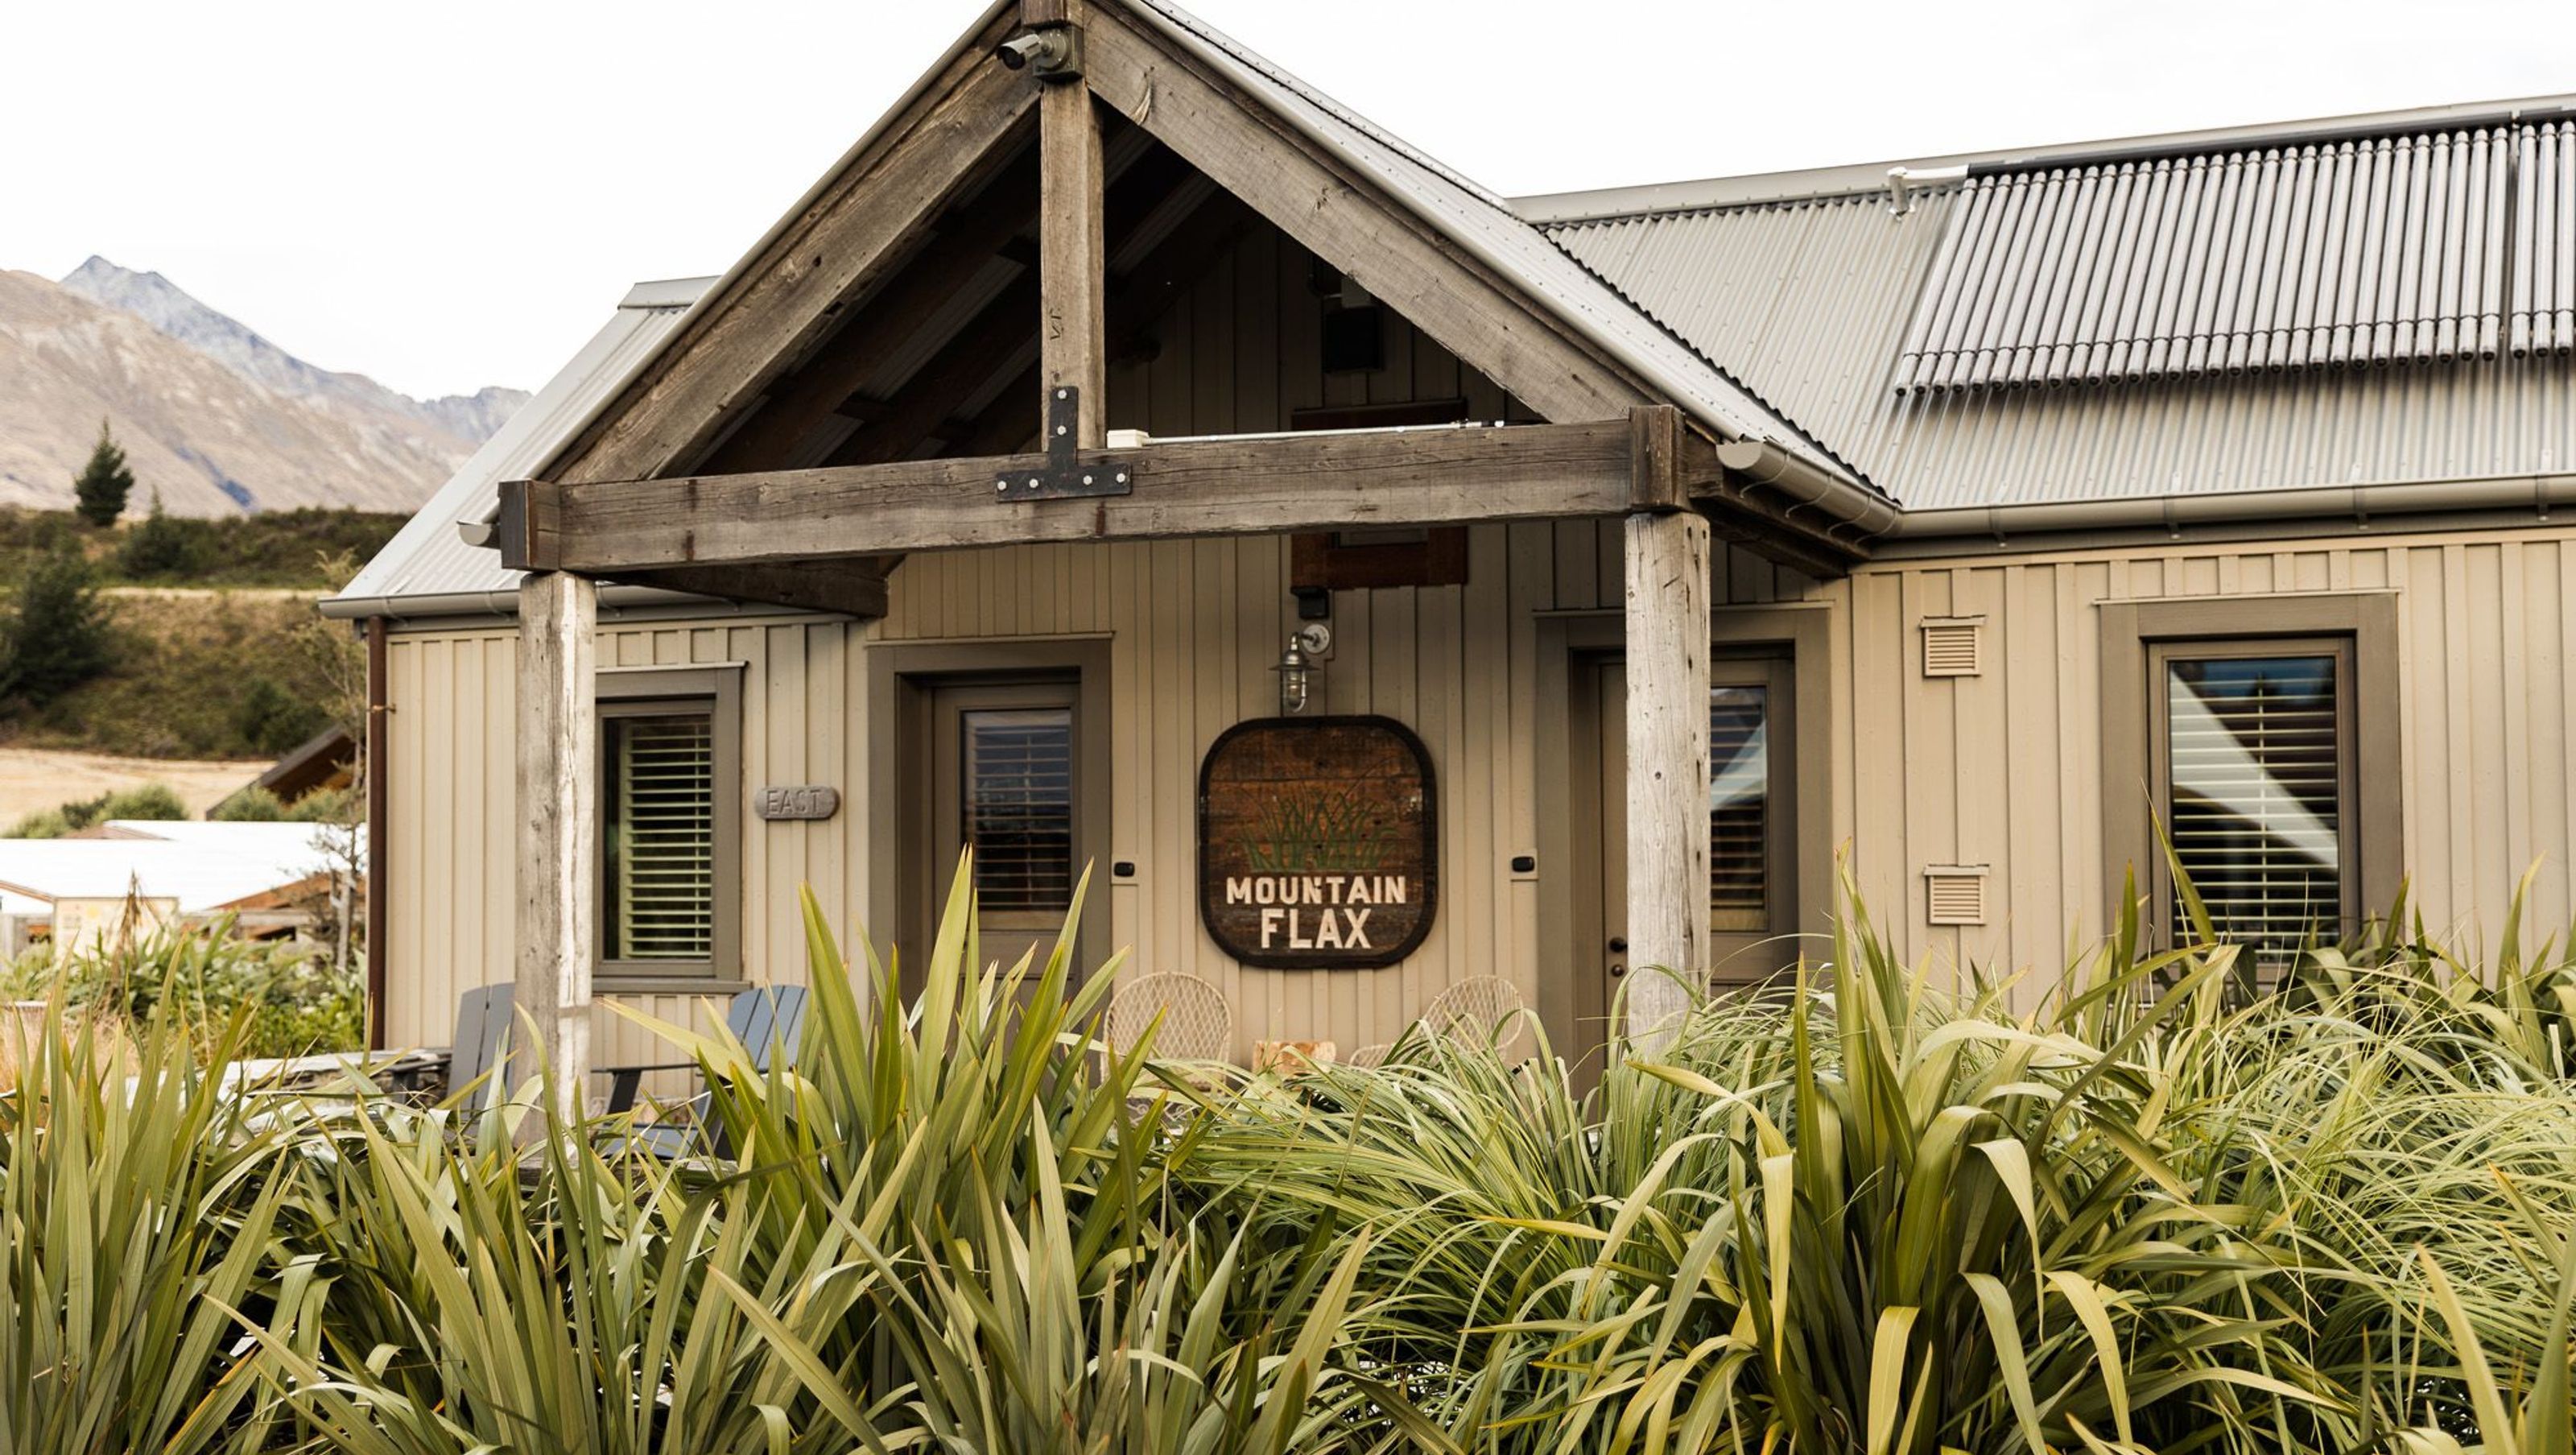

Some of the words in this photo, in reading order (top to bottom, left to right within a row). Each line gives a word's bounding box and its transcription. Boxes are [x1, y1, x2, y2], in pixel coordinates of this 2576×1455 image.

[766, 788, 821, 815] EAST
[1226, 876, 1406, 904] MOUNTAIN
[1261, 908, 1371, 949] FLAX
